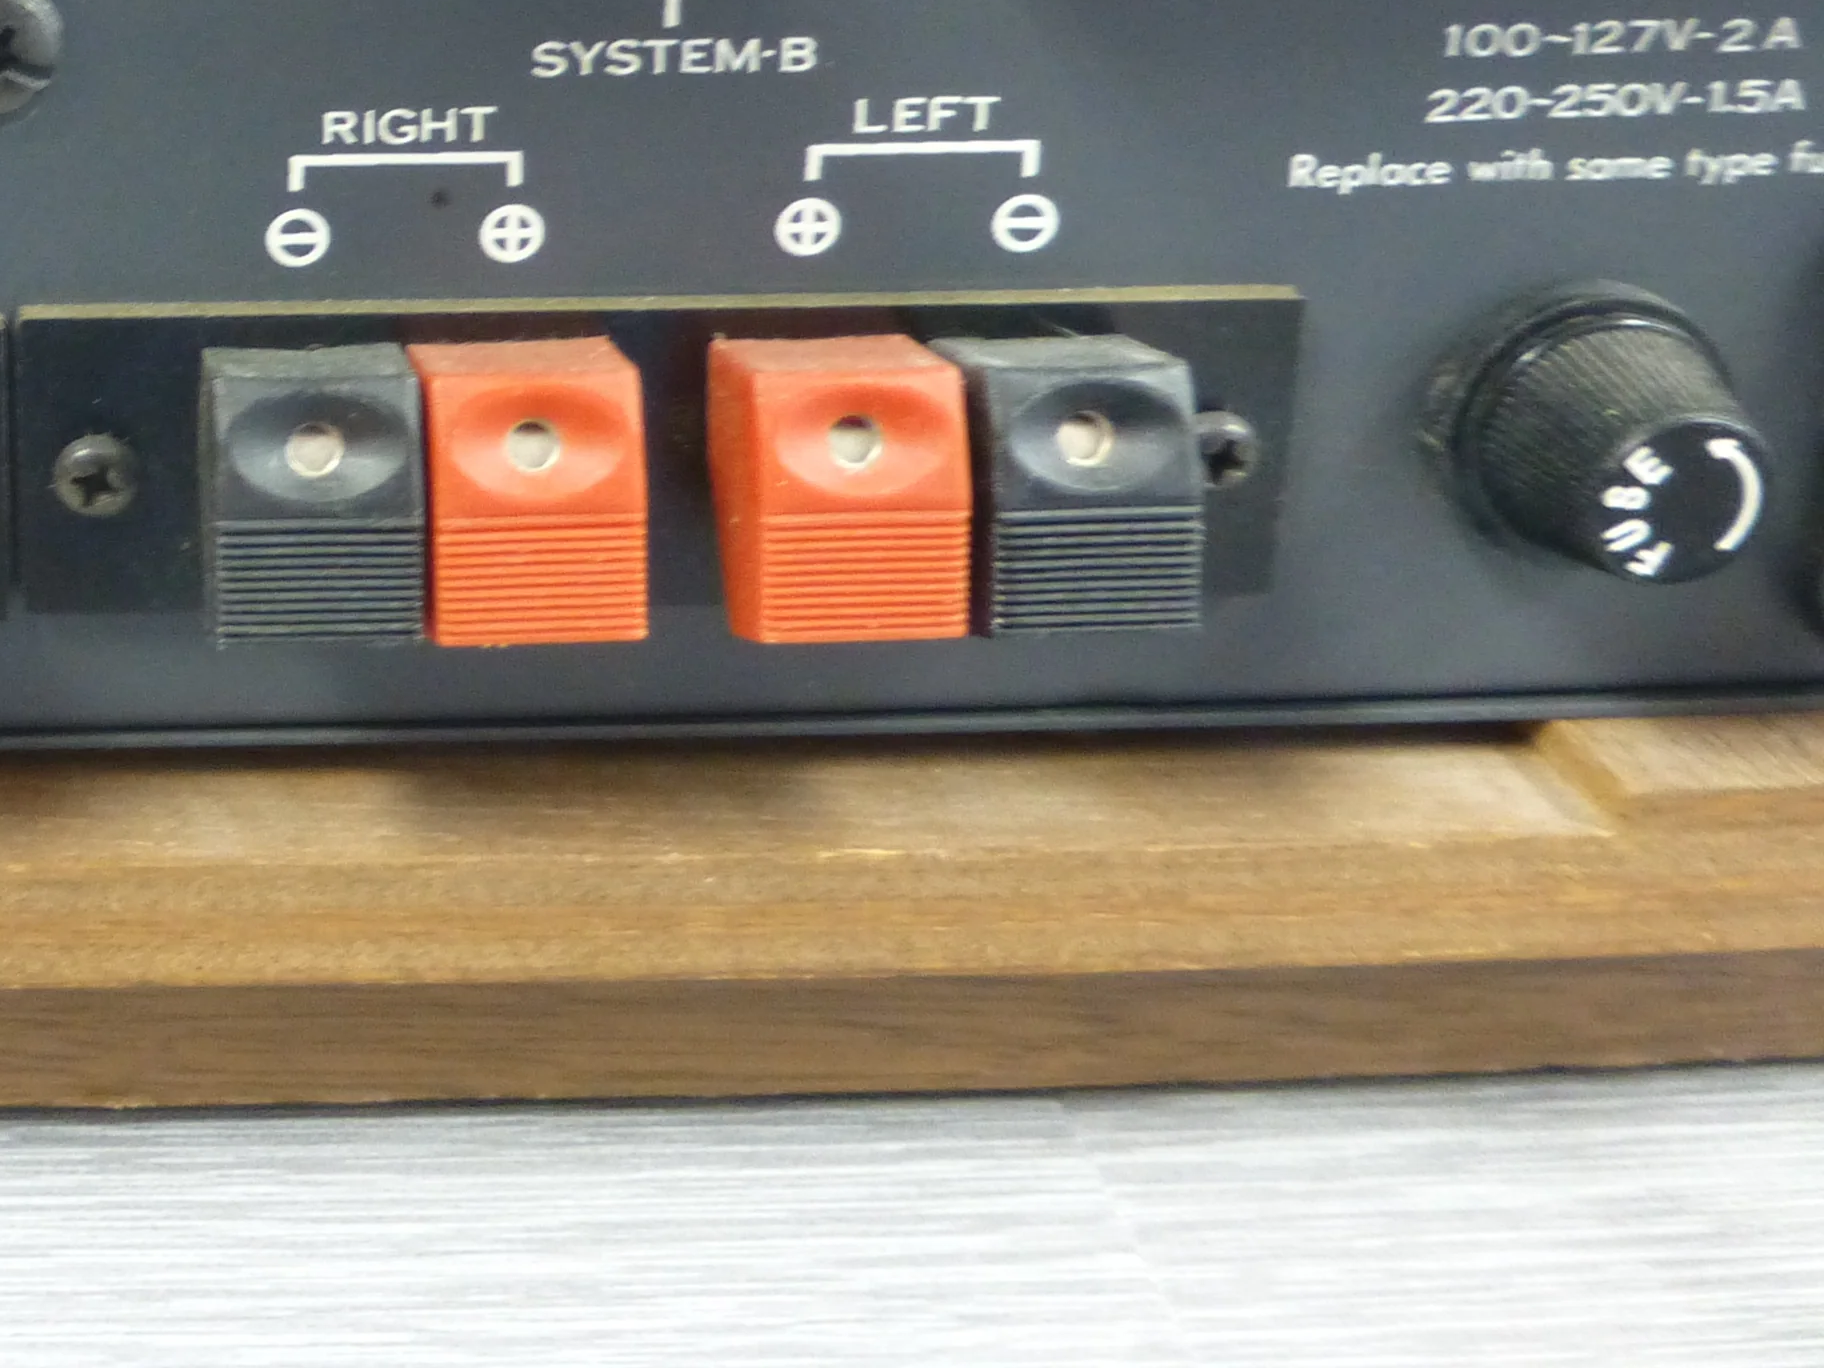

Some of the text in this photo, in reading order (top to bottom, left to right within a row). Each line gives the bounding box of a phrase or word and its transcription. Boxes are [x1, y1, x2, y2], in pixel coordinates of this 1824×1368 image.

[530, 37, 819, 79] SYSTEM-B
[320, 106, 498, 146] RIGHT
[852, 96, 1001, 134] LEFT
[1287, 153, 1454, 195] Replace
[1467, 148, 1555, 181] with
[1564, 155, 1675, 181] same
[1684, 148, 1779, 185] type
[1601, 445, 1673, 578] FUSE
